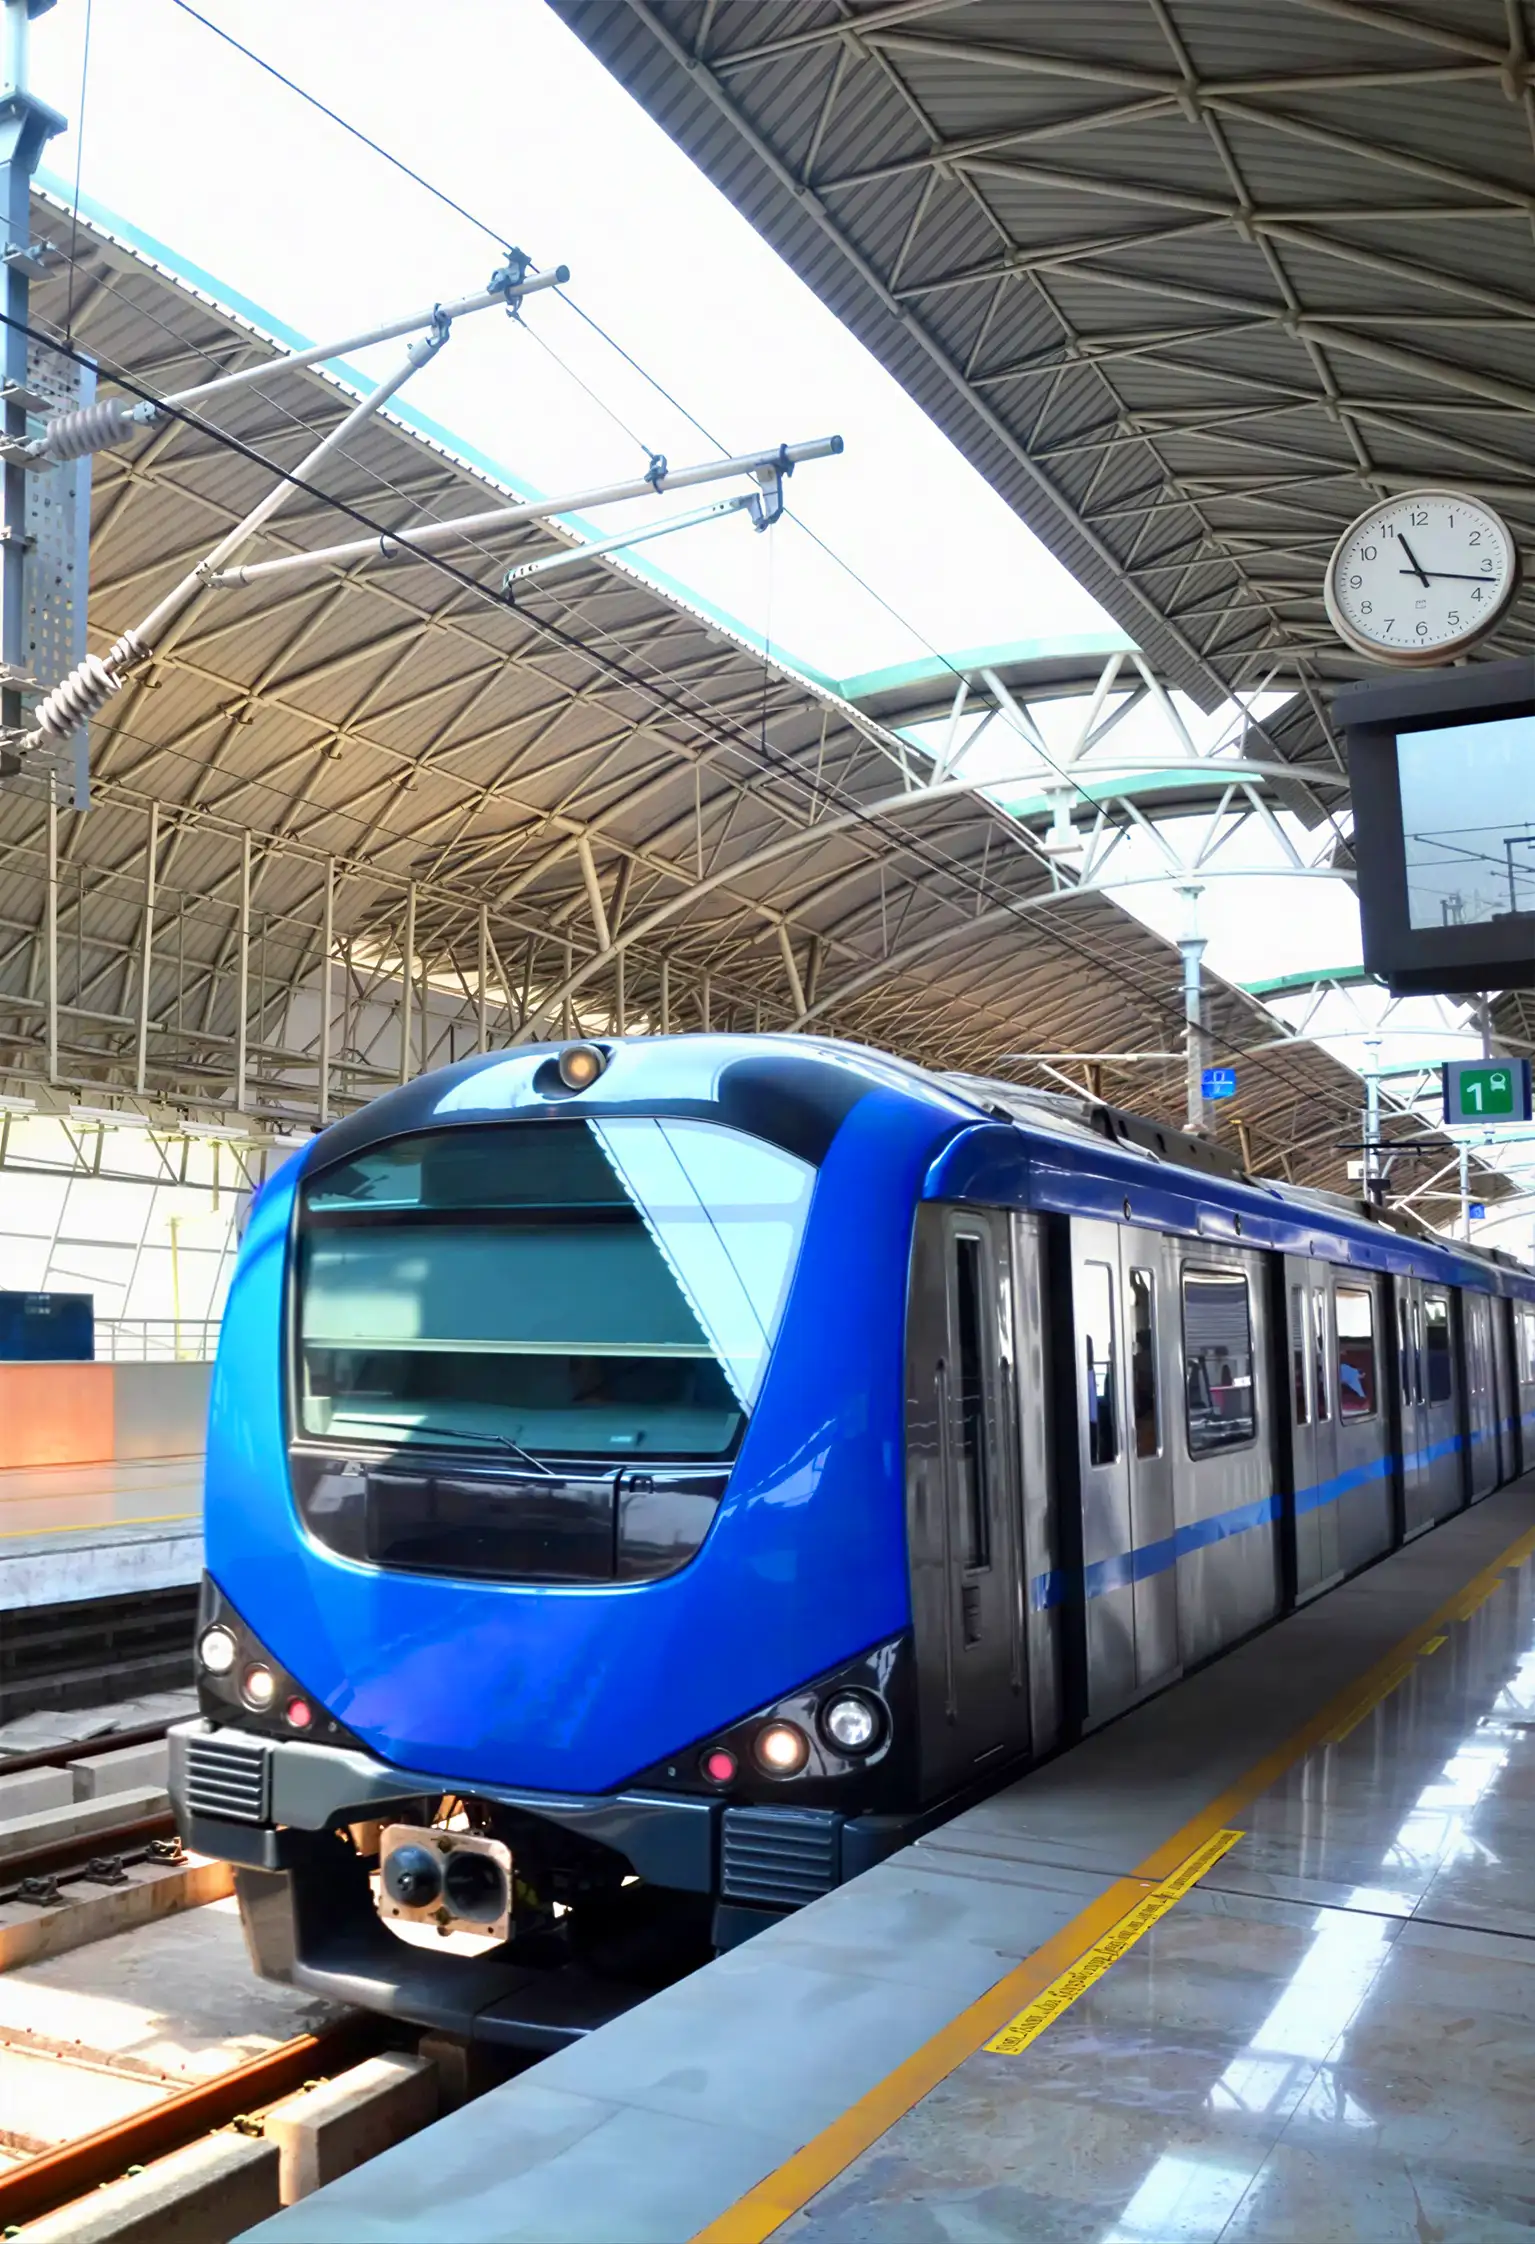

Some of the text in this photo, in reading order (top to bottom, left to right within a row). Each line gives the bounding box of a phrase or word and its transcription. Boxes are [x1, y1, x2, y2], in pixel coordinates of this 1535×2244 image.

[1409, 511, 1429, 526] 12
[1447, 513, 1455, 529] 1
[1380, 524, 1394, 538] 11
[1469, 531, 1481, 546] 2
[1360, 546, 1377, 561] 10
[1480, 558, 1493, 572] 3
[1350, 575, 1363, 590] 9
[1469, 587, 1483, 602] 4
[1360, 600, 1373, 615] 8
[1383, 618, 1395, 633] 7
[1447, 610, 1460, 626] 5
[1415, 621, 1428, 636] 6
[1466, 1082, 1483, 1111] 1
